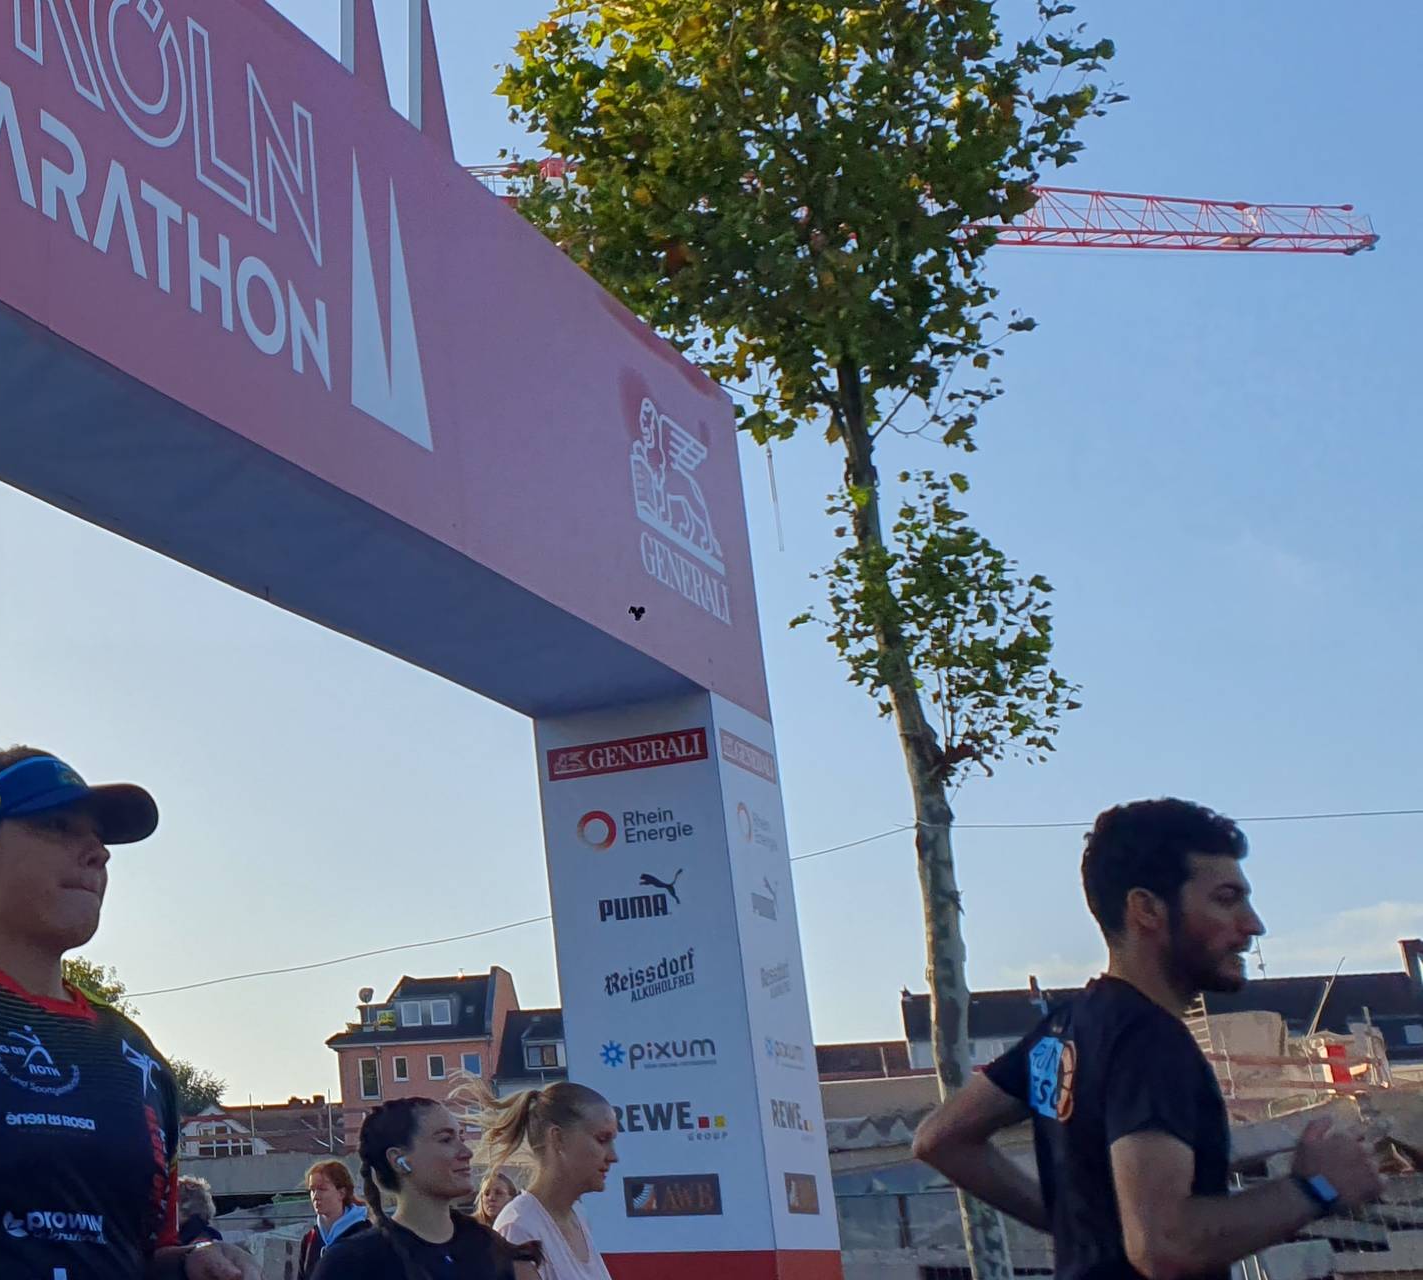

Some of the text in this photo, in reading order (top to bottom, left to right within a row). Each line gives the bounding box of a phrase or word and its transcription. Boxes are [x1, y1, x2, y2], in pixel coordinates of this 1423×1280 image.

[640, 531, 733, 626] GENERALI
[588, 734, 702, 770] GENERALI
[622, 807, 675, 827] Rhein
[624, 823, 694, 844] Energie
[598, 893, 669, 922] PUMA
[603, 947, 695, 996] Reissdorf
[631, 972, 696, 1003] ALKOHOLFREI
[629, 1037, 716, 1070] pixum
[28, 1063, 62, 1077] ROTH
[770, 1099, 803, 1131] REWE
[687, 1131, 729, 1142] GROUP
